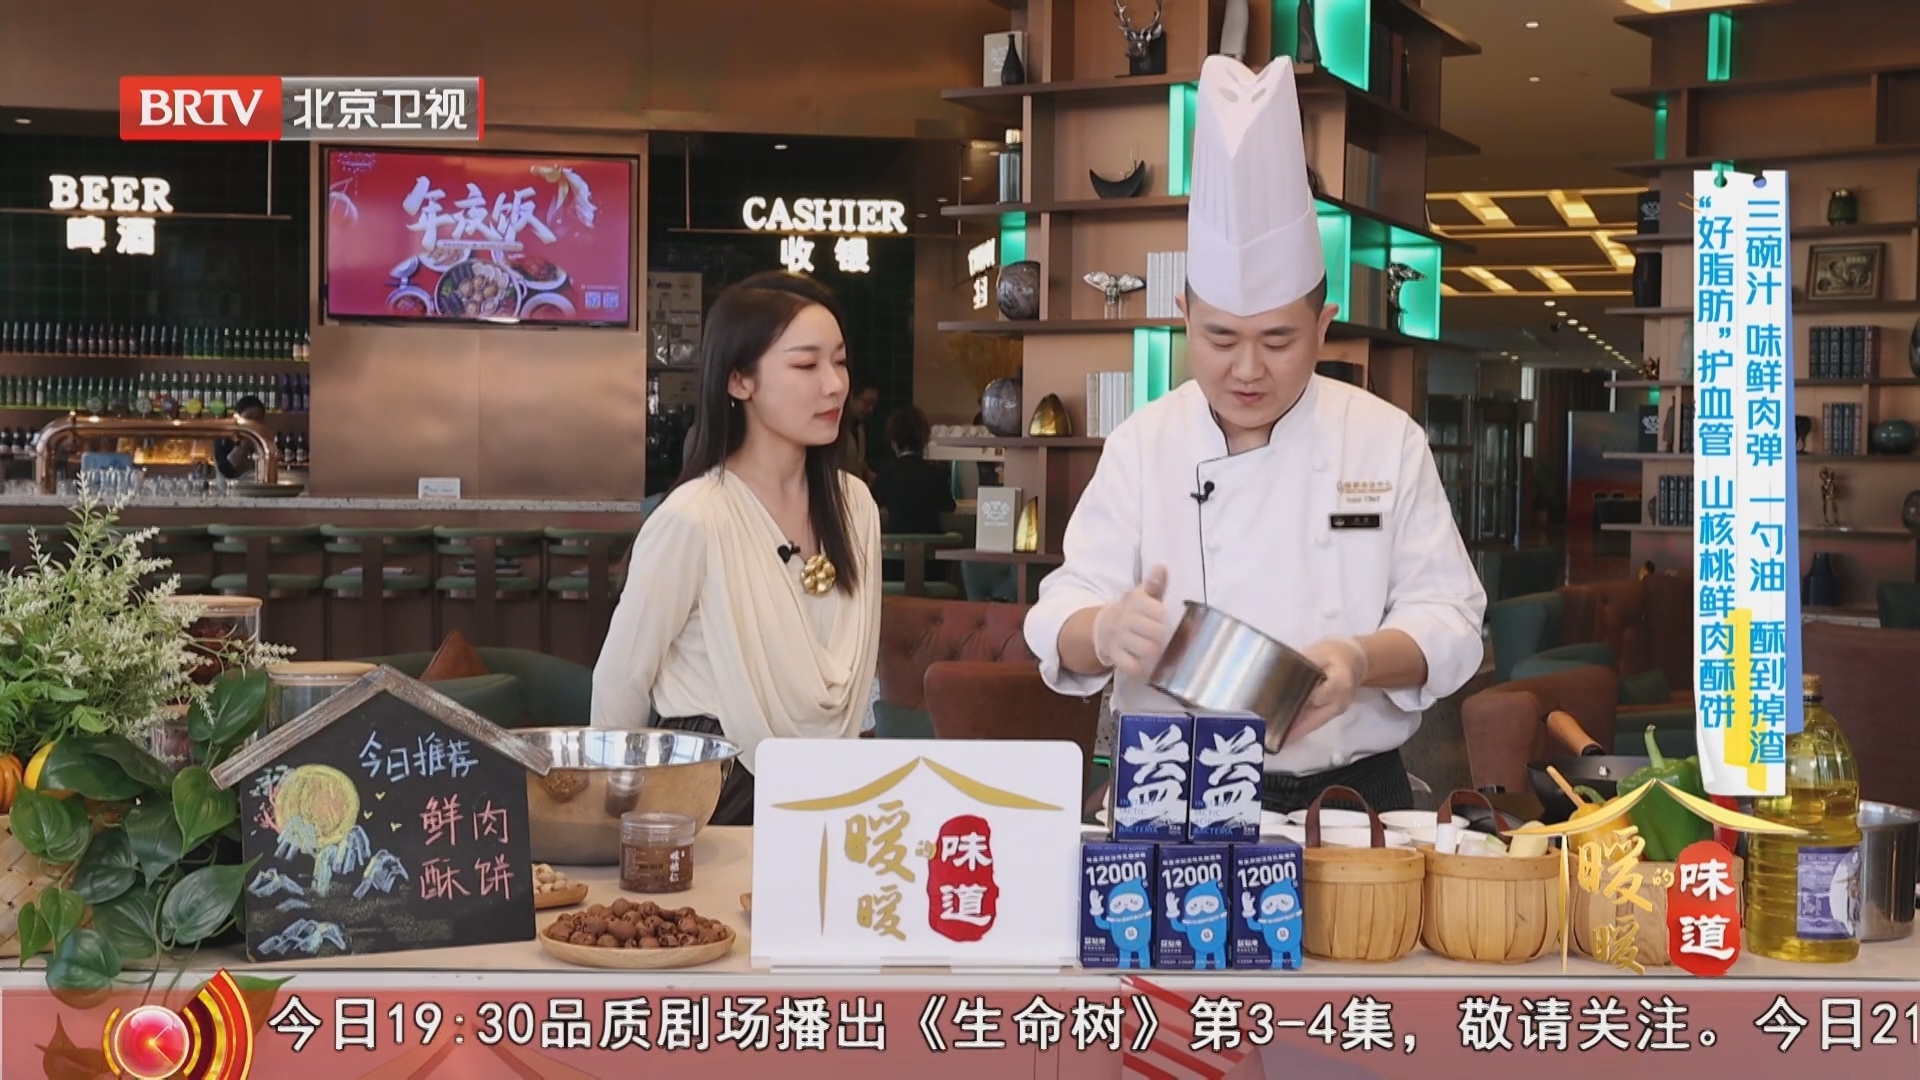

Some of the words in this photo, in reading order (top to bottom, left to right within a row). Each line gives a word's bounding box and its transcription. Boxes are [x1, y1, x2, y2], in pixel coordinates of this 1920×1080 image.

[49, 174, 173, 213] BEER
[402, 175, 557, 250] 年夜饭
[66, 214, 156, 255] 啤酒
[742, 196, 908, 234] CASHIER
[779, 235, 871, 274] 收银
[357, 730, 479, 784] 今日推荐
[420, 793, 510, 846] 鲜肉
[420, 856, 513, 900] 酥饼
[844, 799, 916, 940] 暖暖
[914, 839, 936, 860] 的
[939, 832, 995, 926] 味道
[1085, 861, 1147, 887] 12000
[1162, 863, 1222, 890] 12000
[1237, 861, 1297, 888] 12000
